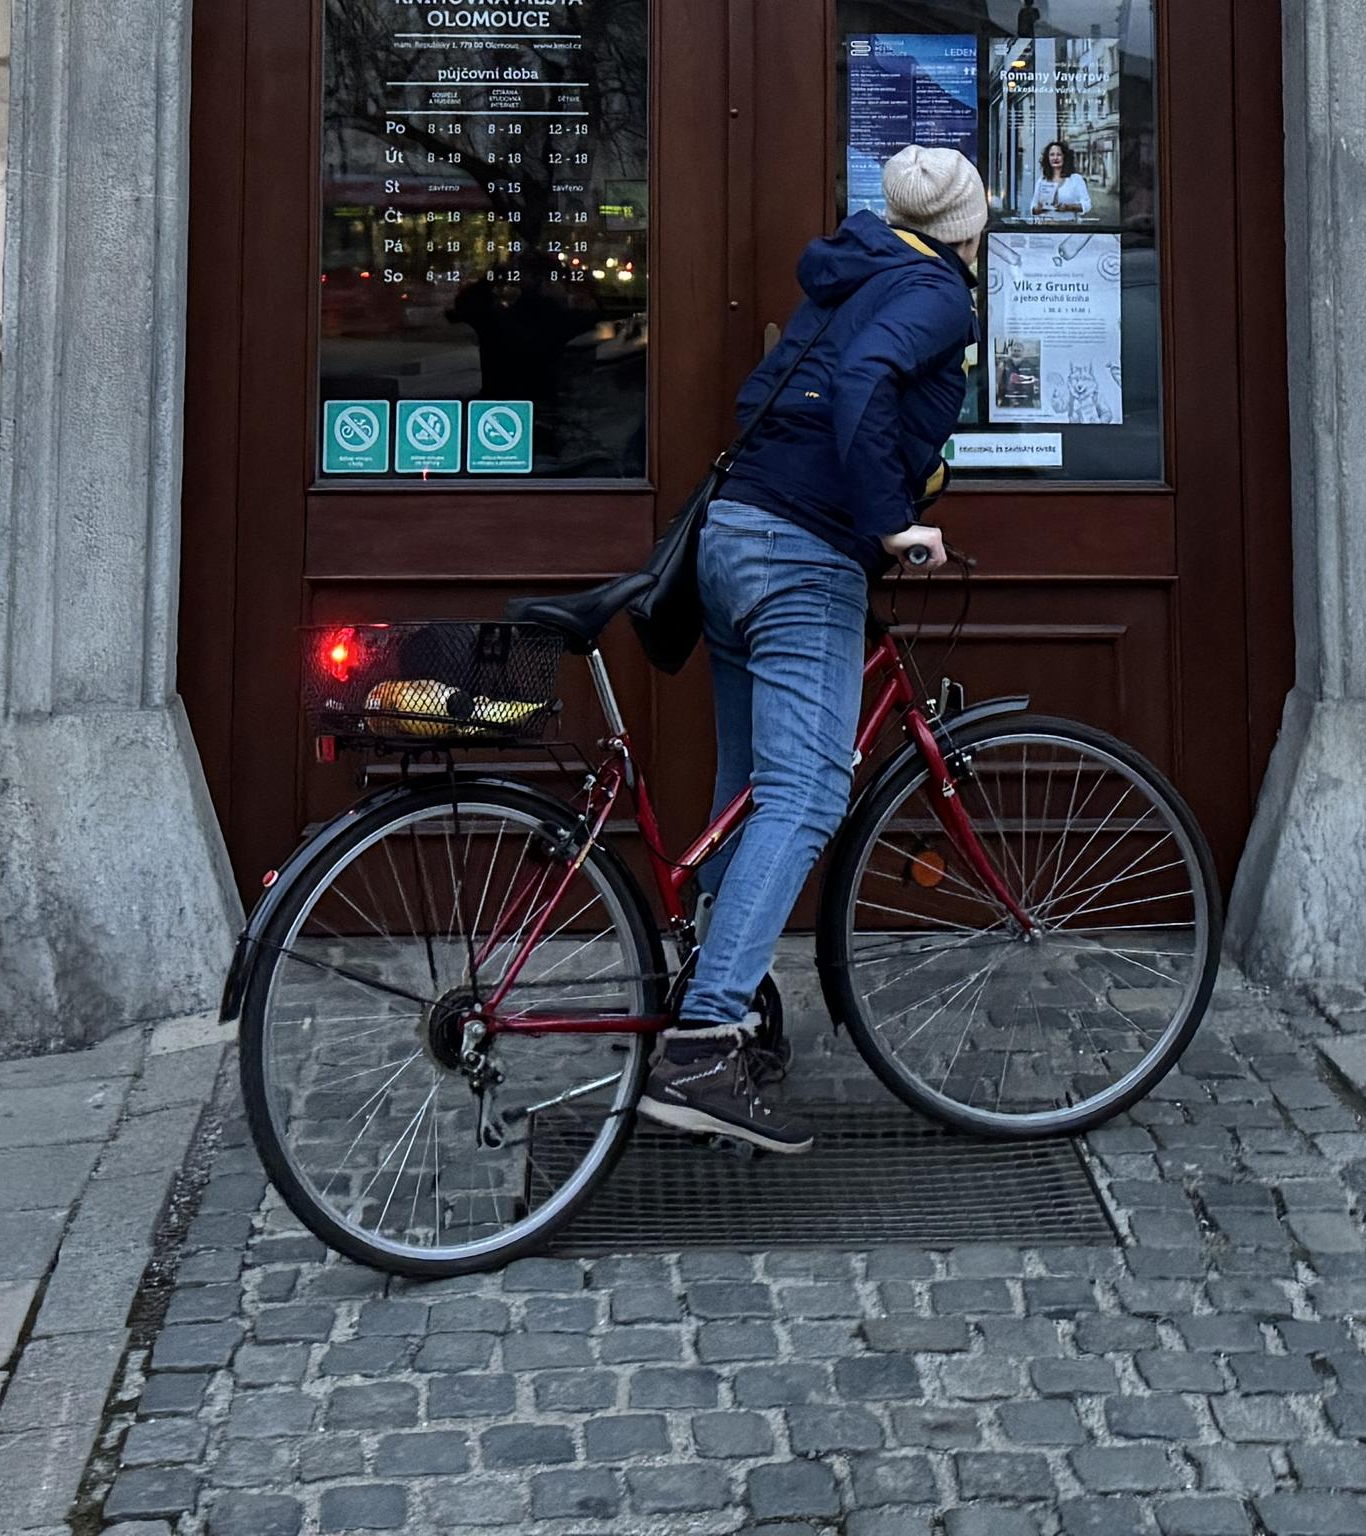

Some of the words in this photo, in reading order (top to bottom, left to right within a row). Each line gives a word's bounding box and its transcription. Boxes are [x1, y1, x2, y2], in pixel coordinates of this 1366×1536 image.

[427, 10, 550, 28] OLOMOUCE
[944, 48, 976, 57] LEDEN
[438, 66, 500, 82] půjčovní
[503, 66, 539, 80] doba
[999, 70, 1049, 83] Romany
[386, 121, 406, 134] Po
[428, 123, 435, 134] 8
[447, 123, 461, 134] 18
[488, 123, 495, 134] 8
[508, 123, 521, 134] 18
[548, 123, 562, 134] 12
[575, 123, 588, 134] 18
[385, 146, 404, 163] Út
[427, 153, 435, 163] 8
[447, 153, 461, 163] 18
[488, 153, 495, 163] 8
[508, 153, 521, 163] 18
[548, 153, 562, 163] 12
[575, 153, 588, 163] 18
[385, 179, 400, 193] St
[487, 182, 495, 193] 9
[507, 182, 521, 193] 15
[384, 206, 403, 223] Čt
[426, 212, 434, 222] 8
[447, 212, 460, 222] 18
[487, 212, 495, 222] 8
[508, 212, 521, 222] 18
[548, 212, 562, 222] 12
[575, 212, 587, 222] 18
[384, 239, 403, 253] Pá
[426, 241, 434, 252] 8
[447, 241, 460, 252] 18
[487, 241, 495, 252] 8
[507, 241, 521, 252] 18
[548, 241, 562, 252] 12
[575, 241, 587, 252] 18
[384, 269, 403, 282] So
[426, 271, 434, 281] 8
[446, 271, 460, 281] 12
[487, 271, 494, 281] 8
[507, 271, 520, 281] 12
[550, 271, 558, 281] 8
[570, 271, 584, 281] 12
[1013, 280, 1033, 292] Vlk
[1036, 282, 1042, 292] z
[1045, 281, 1089, 292] Gruntu
